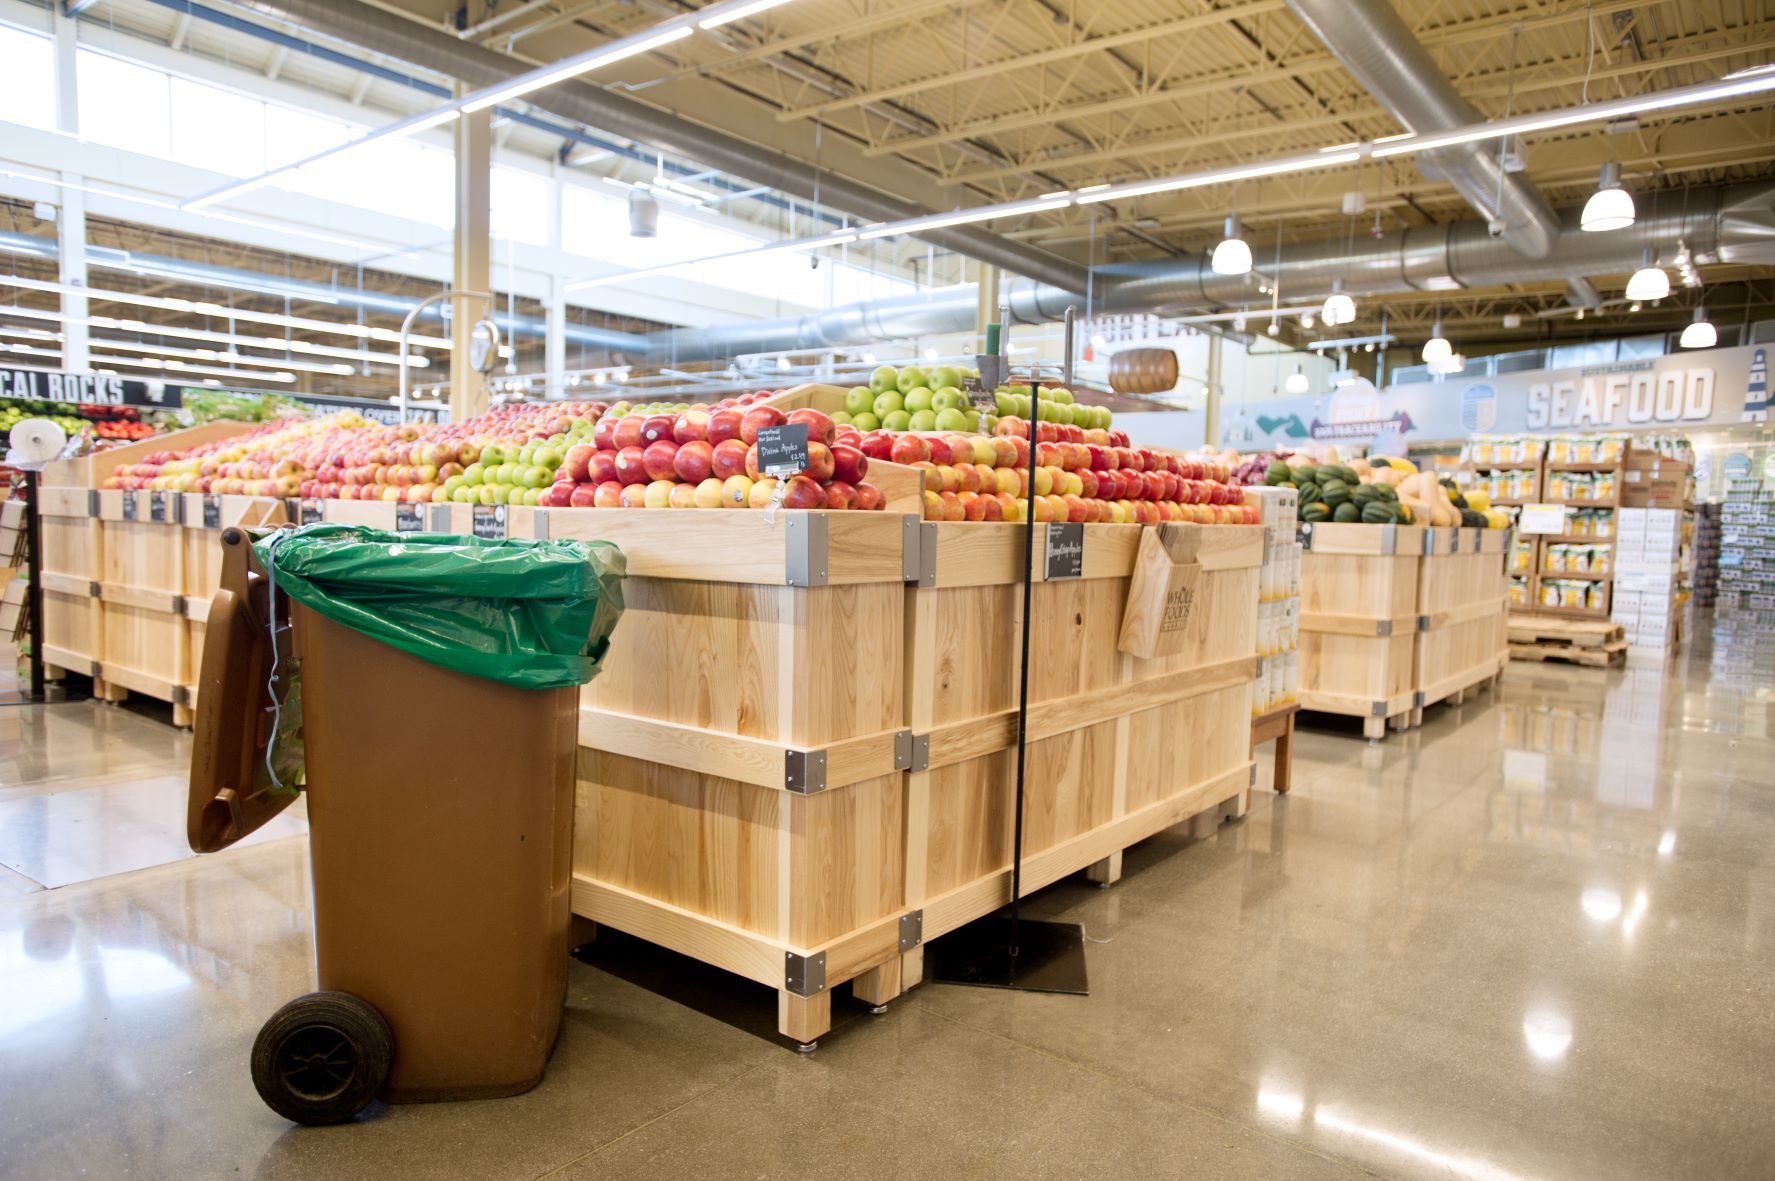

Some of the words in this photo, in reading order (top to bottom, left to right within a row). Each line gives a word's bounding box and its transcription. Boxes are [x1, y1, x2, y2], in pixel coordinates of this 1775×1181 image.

[47, 372, 125, 406] ROCKS
[1527, 367, 1716, 431] SEAFOOD
[1166, 588, 1194, 605] WHOLE
[1164, 603, 1190, 620] FOODS
